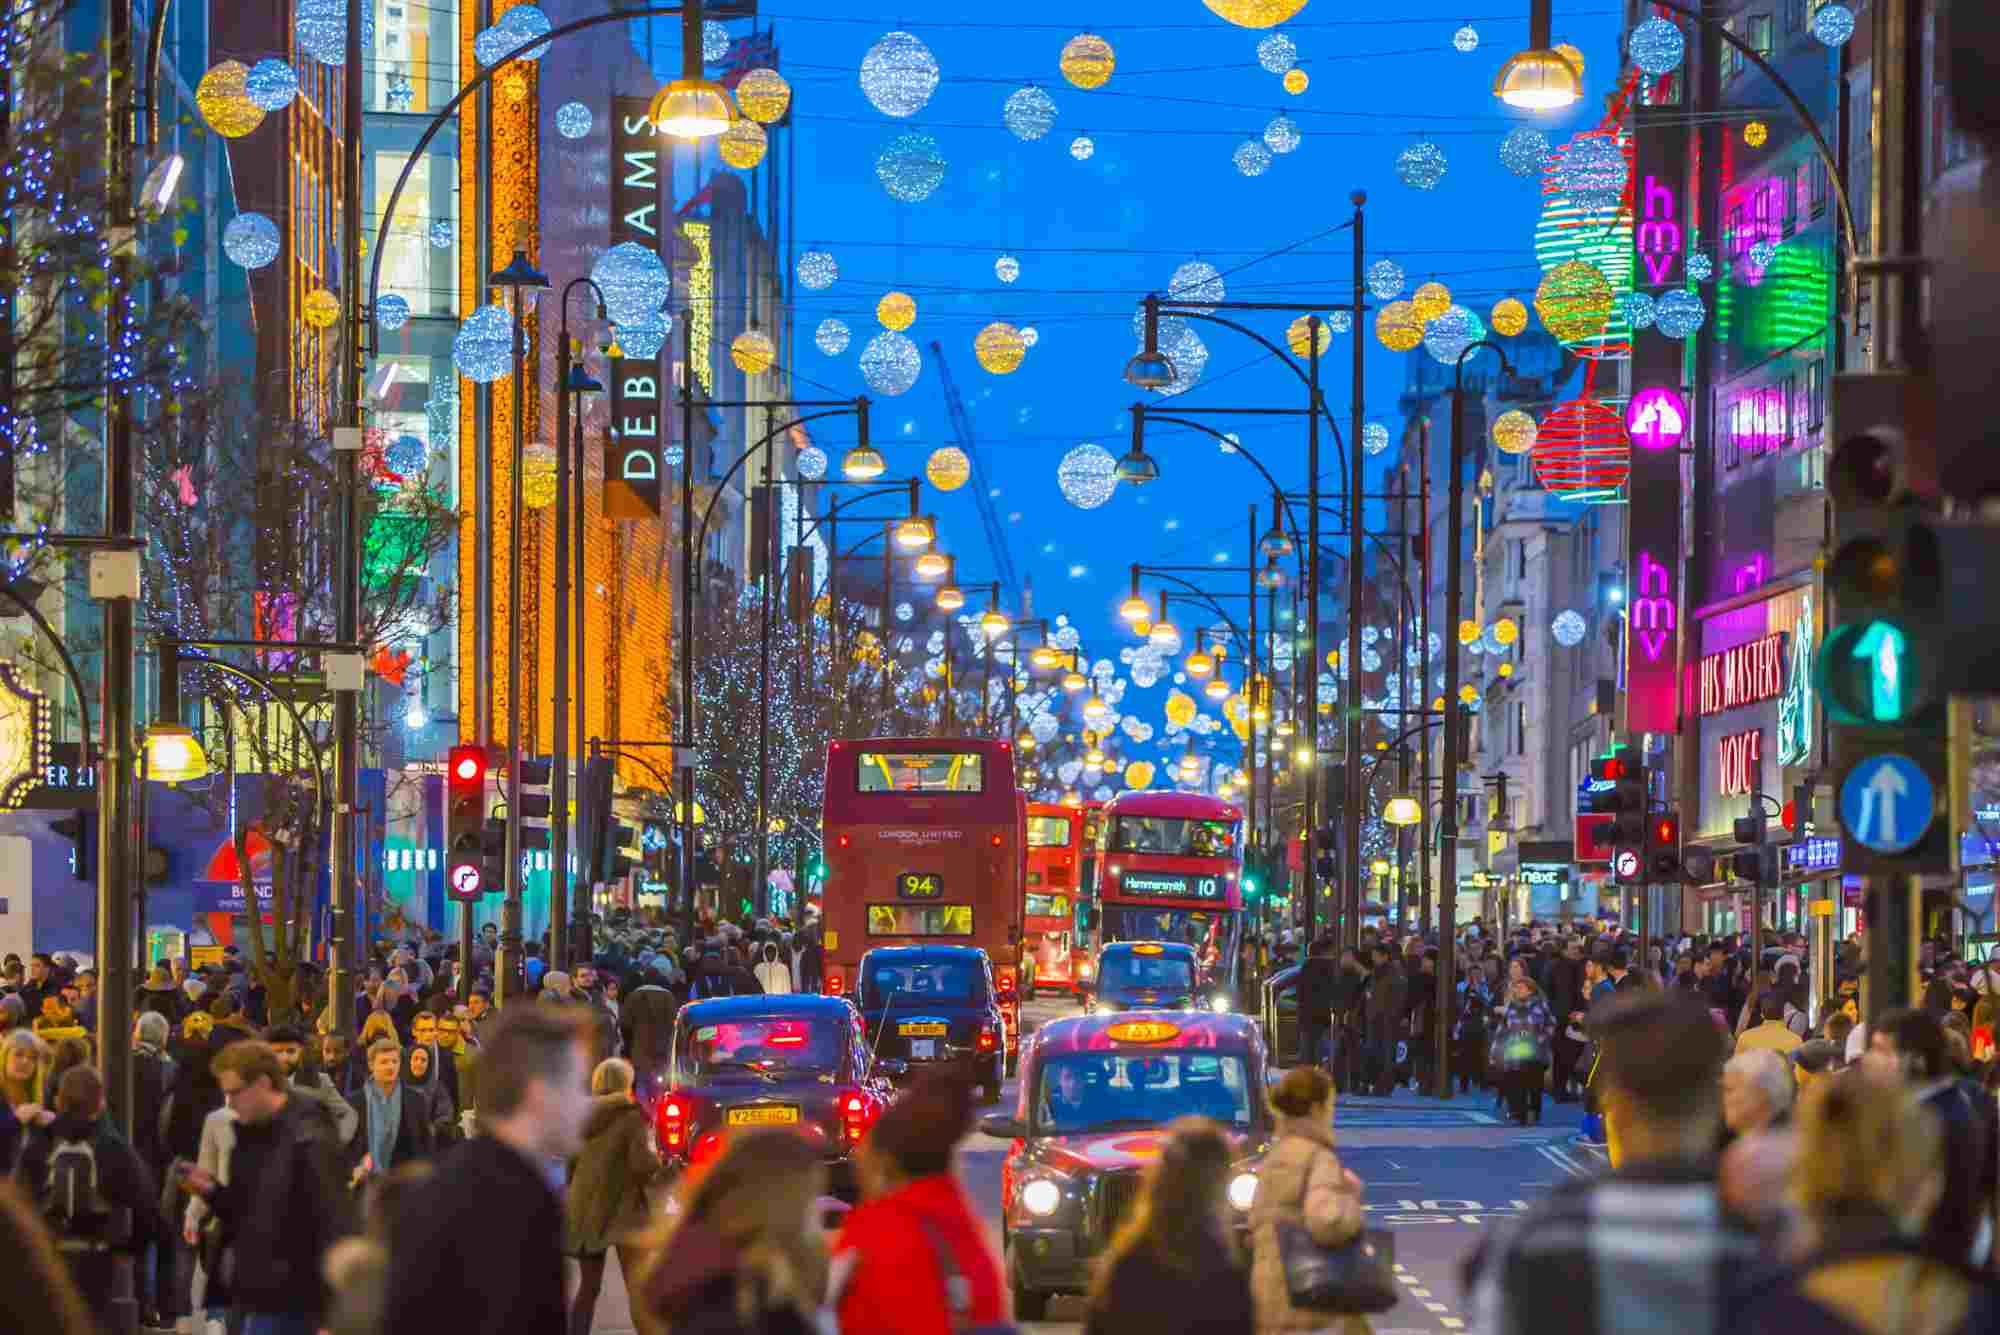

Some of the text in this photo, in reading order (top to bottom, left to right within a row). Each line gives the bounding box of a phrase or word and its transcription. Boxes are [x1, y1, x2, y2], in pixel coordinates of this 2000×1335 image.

[1637, 175, 1681, 286] hmv
[623, 115, 657, 481] DEBAMS
[1632, 550, 1676, 664] hmv
[1700, 655, 1721, 715] HIS
[906, 875, 935, 895] 94
[1199, 879, 1216, 896] 10
[1520, 871, 1558, 885] next
